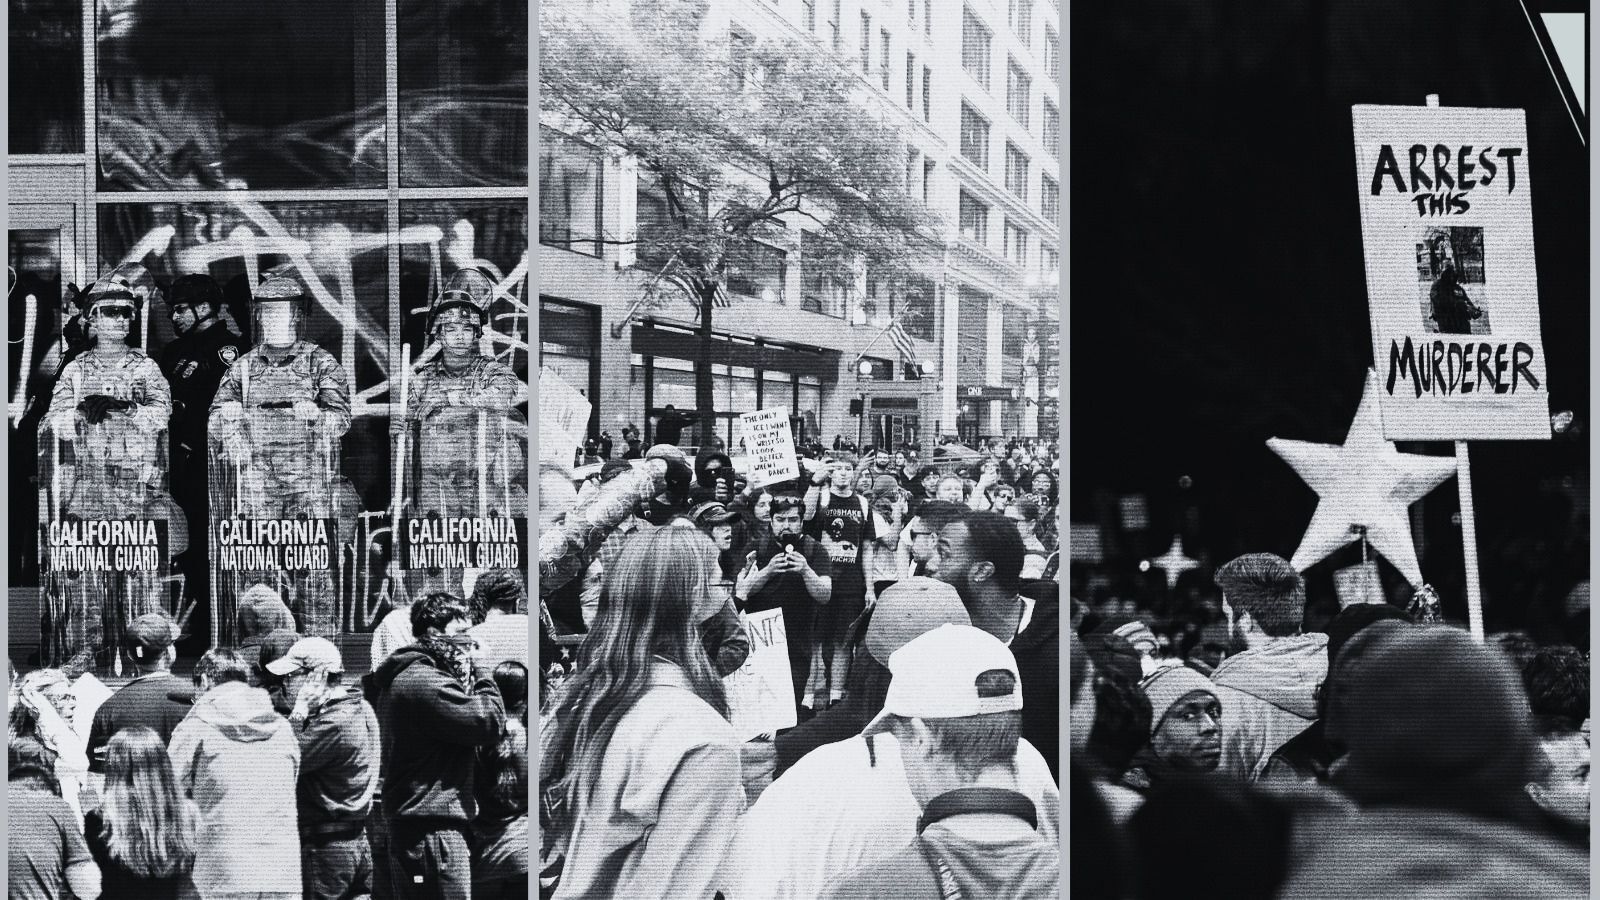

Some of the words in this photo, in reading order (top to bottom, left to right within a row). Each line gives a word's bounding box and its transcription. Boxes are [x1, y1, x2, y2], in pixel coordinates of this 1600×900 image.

[1371, 144, 1522, 196] ARREST
[1411, 191, 1471, 218] THIS
[1386, 336, 1540, 398] MURDERER
[743, 415, 757, 423] THE
[758, 411, 777, 421] ONLY
[770, 420, 788, 430] WANT
[769, 430, 779, 438] MY
[755, 447, 775, 455] LOOK
[759, 452, 784, 463] BETTER
[768, 467, 790, 477] DANCE
[49, 521, 157, 546] CALIFORNIA
[219, 520, 328, 546] CALIFORNIA
[408, 518, 517, 545] CALIFORNIA
[50, 546, 112, 571] NATIONAL
[115, 545, 159, 571] GUARD
[220, 545, 282, 571] NATIONAL
[285, 545, 329, 570] GUARD
[409, 544, 471, 569] NATIONAL
[474, 543, 519, 569] GUARD
